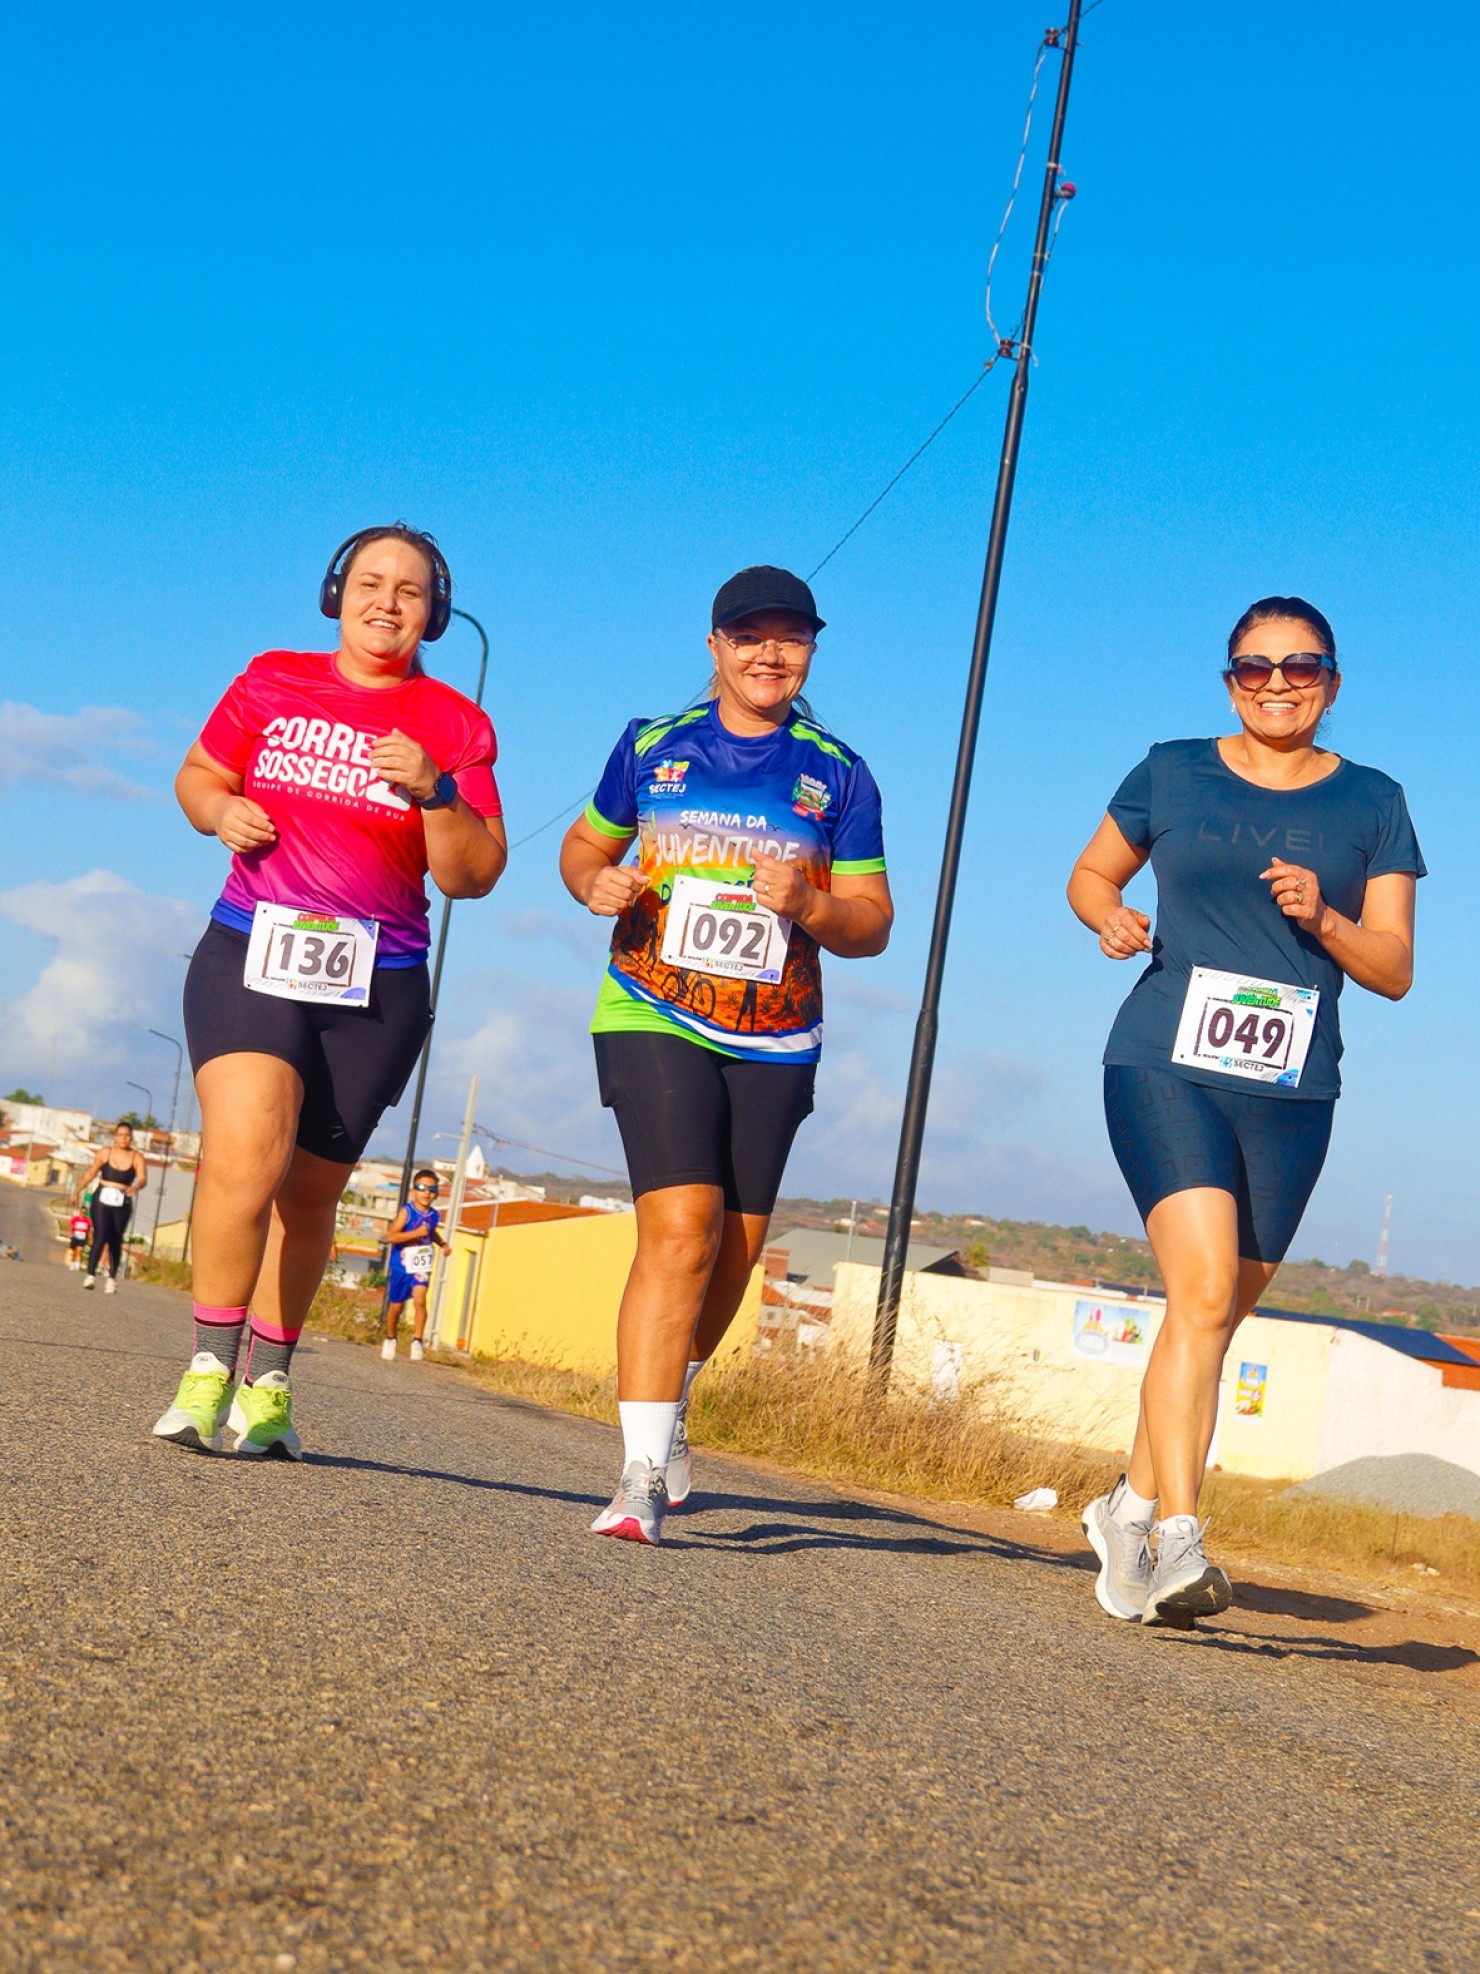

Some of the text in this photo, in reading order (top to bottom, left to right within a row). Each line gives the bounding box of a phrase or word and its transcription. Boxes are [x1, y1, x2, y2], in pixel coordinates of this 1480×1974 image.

[262, 716, 377, 767] CORRE
[254, 749, 368, 797] SOSSEGO
[649, 783, 686, 795] SECTEJ
[252, 780, 406, 822] EQUIPE DE CORRIDA DE RUA
[680, 811, 767, 831] SEMANA DA
[656, 833, 800, 867] JUVENTUDE
[1197, 821, 1325, 853] LIVE!
[279, 932, 349, 979] 136
[692, 913, 765, 959] 092
[1207, 1007, 1286, 1059] 049
